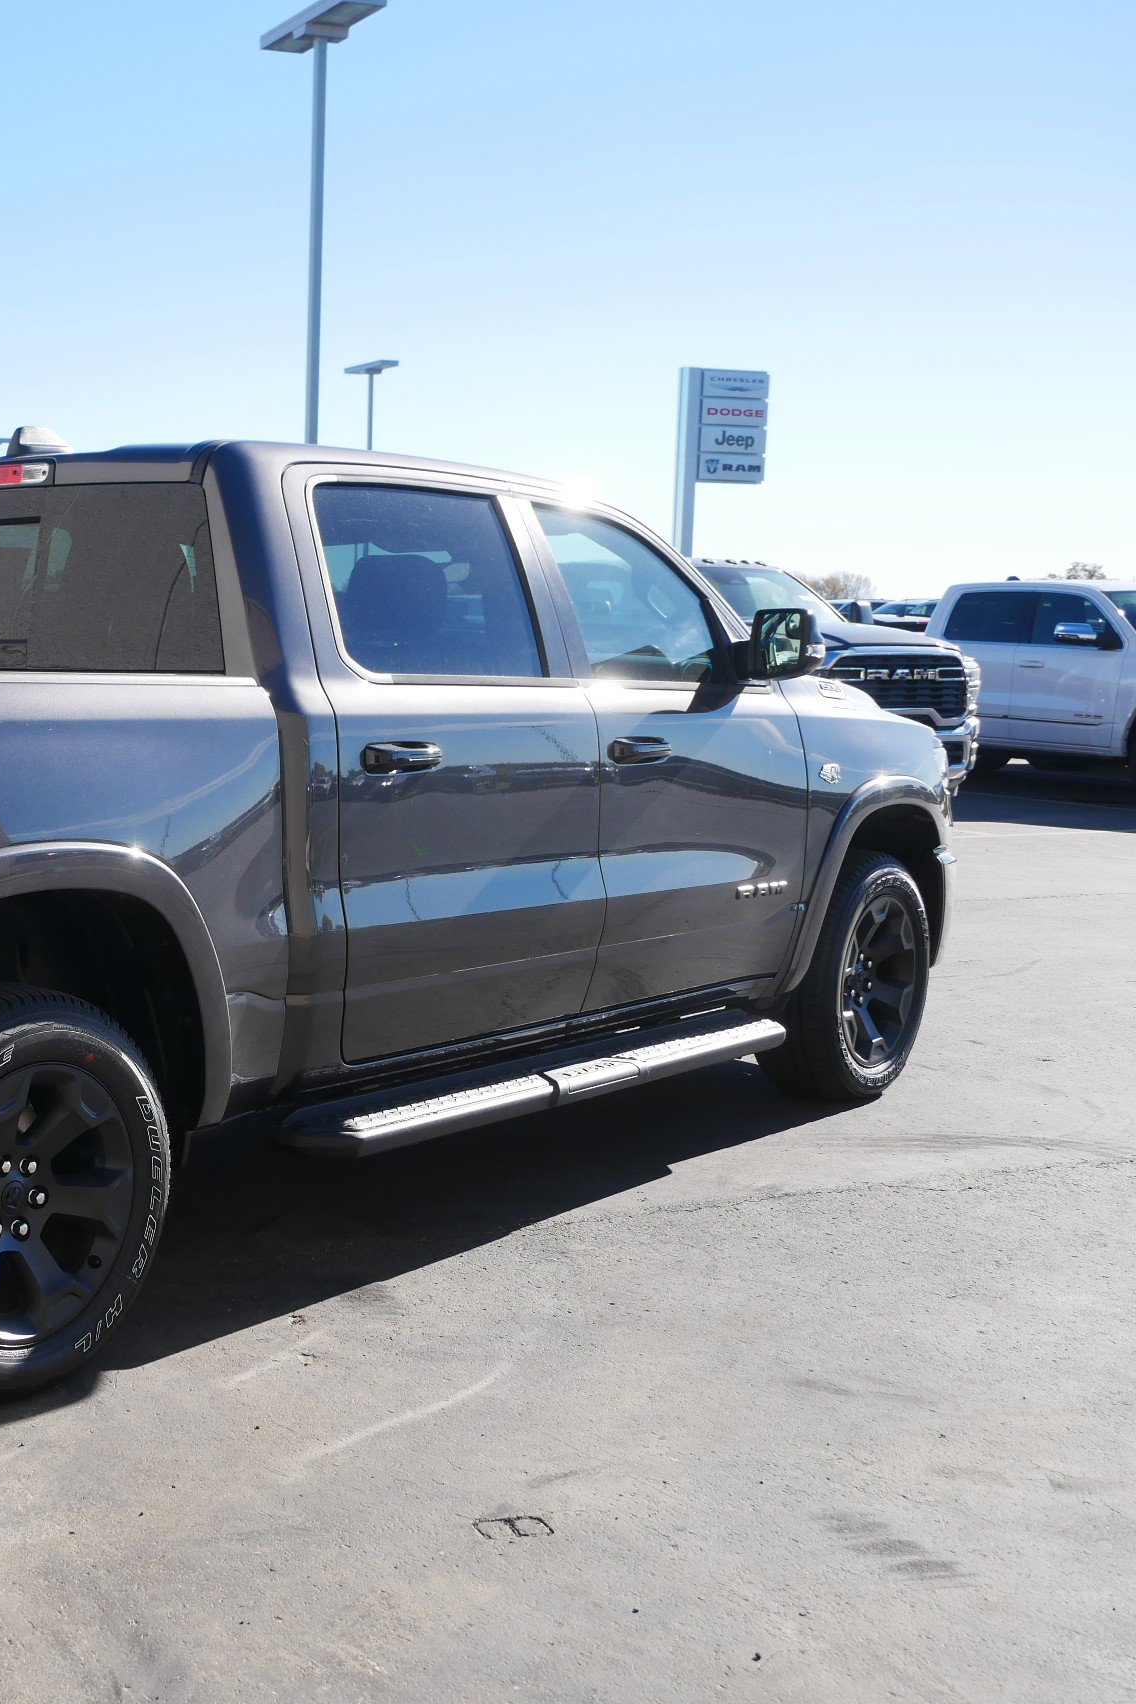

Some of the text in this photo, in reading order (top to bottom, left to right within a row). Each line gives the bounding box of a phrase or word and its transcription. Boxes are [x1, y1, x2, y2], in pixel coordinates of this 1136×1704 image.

[710, 376, 764, 384] CHRYSLER
[707, 407, 764, 418] DODGE
[714, 430, 755, 450] Jeep
[722, 463, 761, 473] RAM
[867, 668, 937, 681] RAM
[735, 880, 788, 900] RAM
[132, 1095, 164, 1278] DUELER
